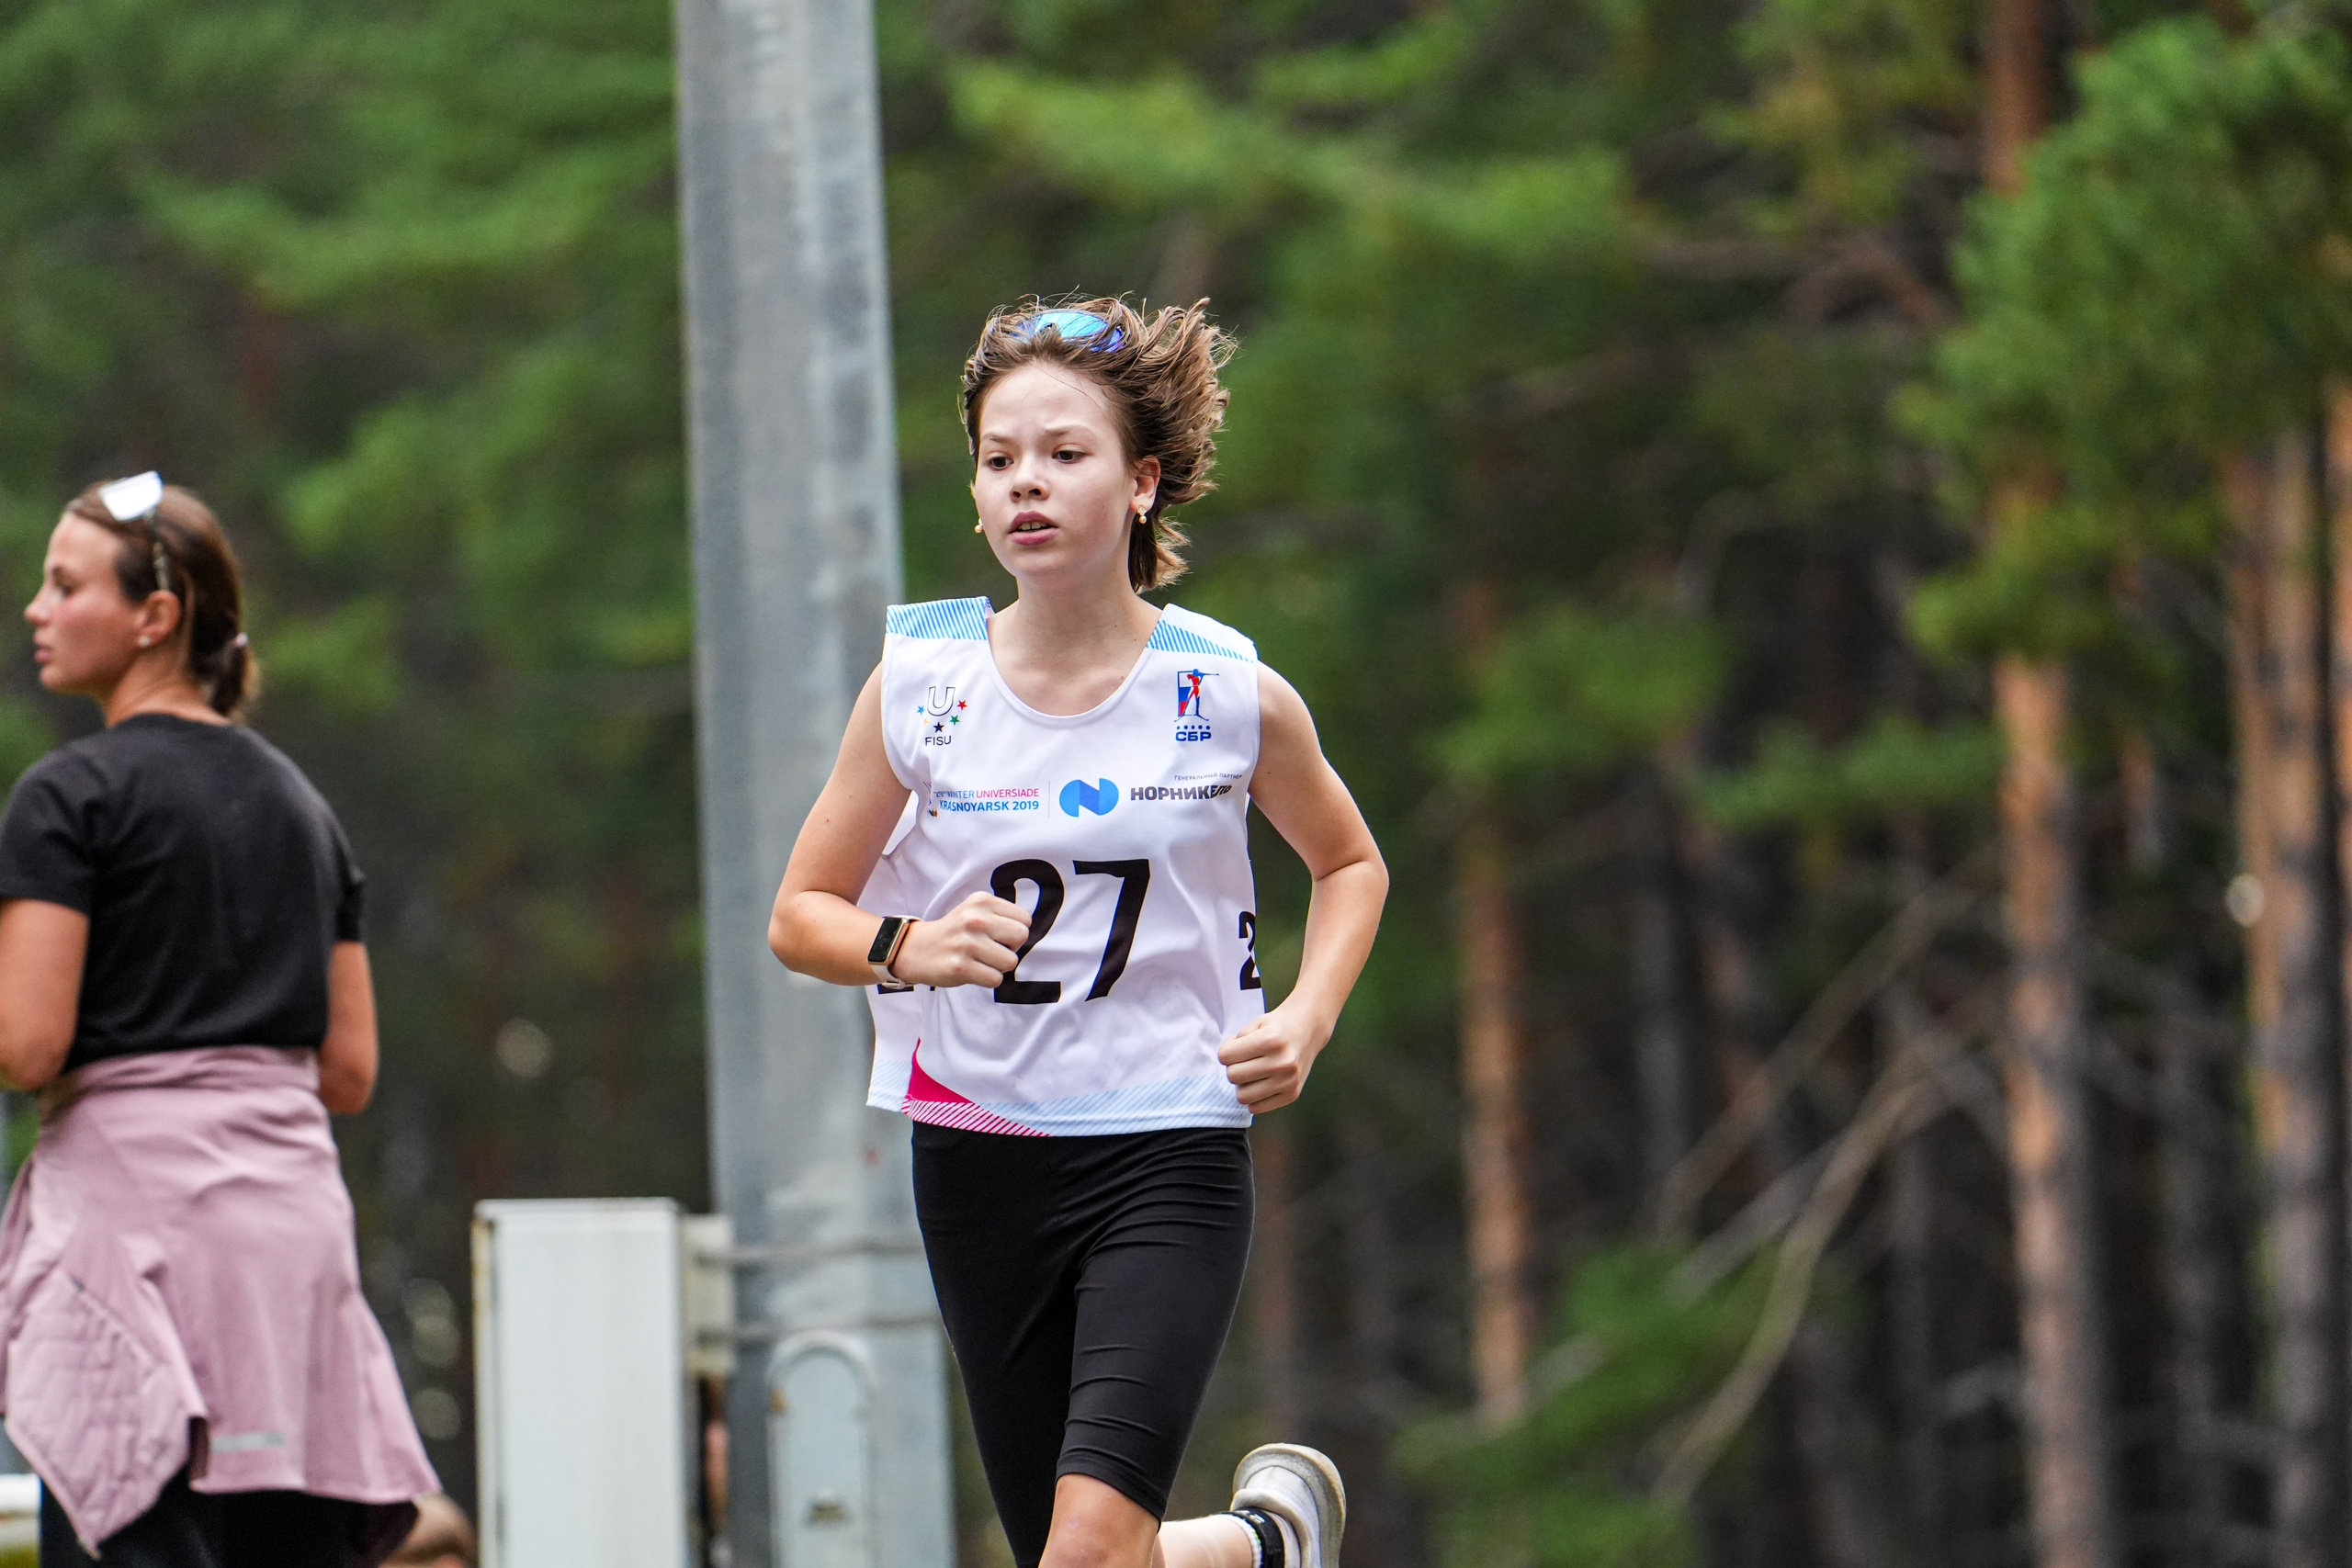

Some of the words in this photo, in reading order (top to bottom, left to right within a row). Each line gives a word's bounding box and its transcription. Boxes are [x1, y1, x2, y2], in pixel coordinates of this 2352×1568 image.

[924, 735, 952, 746] FISU
[1175, 731, 1212, 741] СБР
[976, 788, 1040, 798] UNIVERSIADE
[939, 799, 1010, 812] KRASNOYARSK
[1012, 800, 1039, 810] 2019
[990, 858, 1151, 1005] 27
